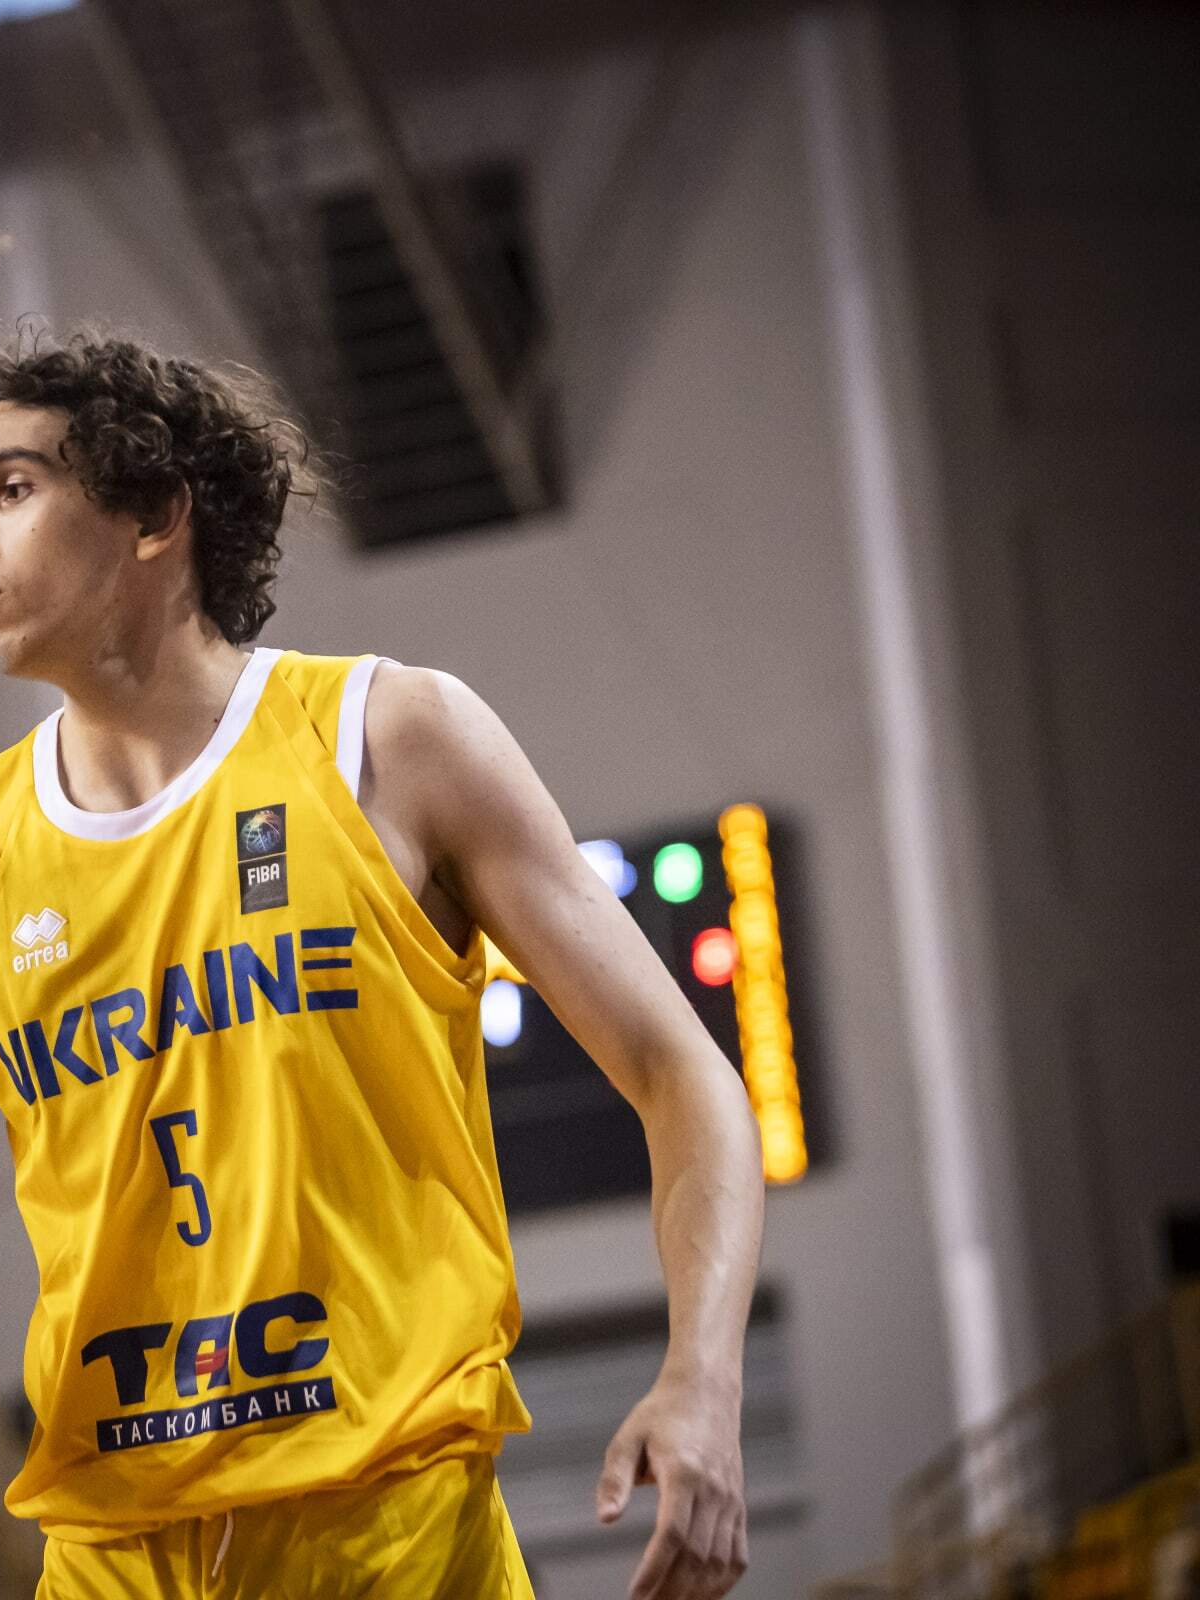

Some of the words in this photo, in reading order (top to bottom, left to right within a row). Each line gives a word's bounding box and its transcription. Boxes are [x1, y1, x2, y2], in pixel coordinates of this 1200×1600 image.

[247, 863, 280, 886] FIBA
[13, 941, 68, 974] errea
[150, 1109, 212, 1247] 5
[81, 1291, 330, 1406] ТАС
[111, 1385, 321, 1446] ТАСКОМБАНК
